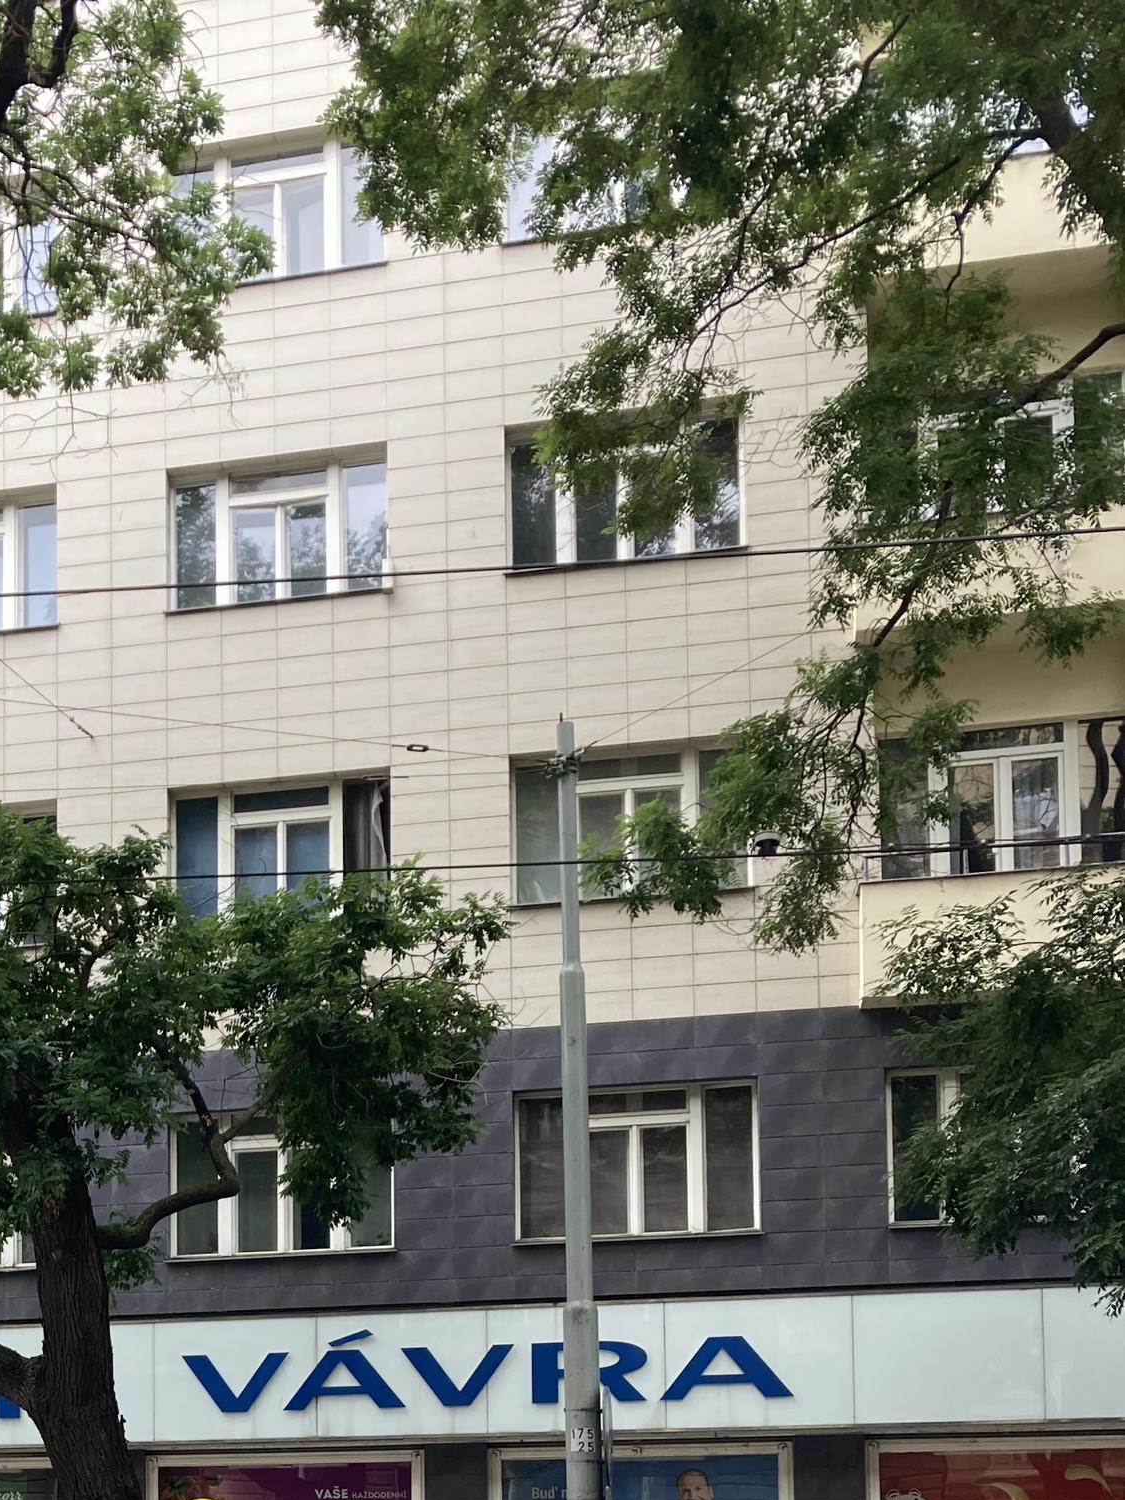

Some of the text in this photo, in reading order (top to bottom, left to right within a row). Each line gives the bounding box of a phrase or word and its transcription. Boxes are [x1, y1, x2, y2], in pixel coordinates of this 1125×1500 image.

[182, 1329, 794, 1413] VÁVRA
[572, 1428, 594, 1440] 175
[578, 1441, 594, 1452] 25
[315, 1486, 407, 1499] VAŠE KAŽDODENNÍ
